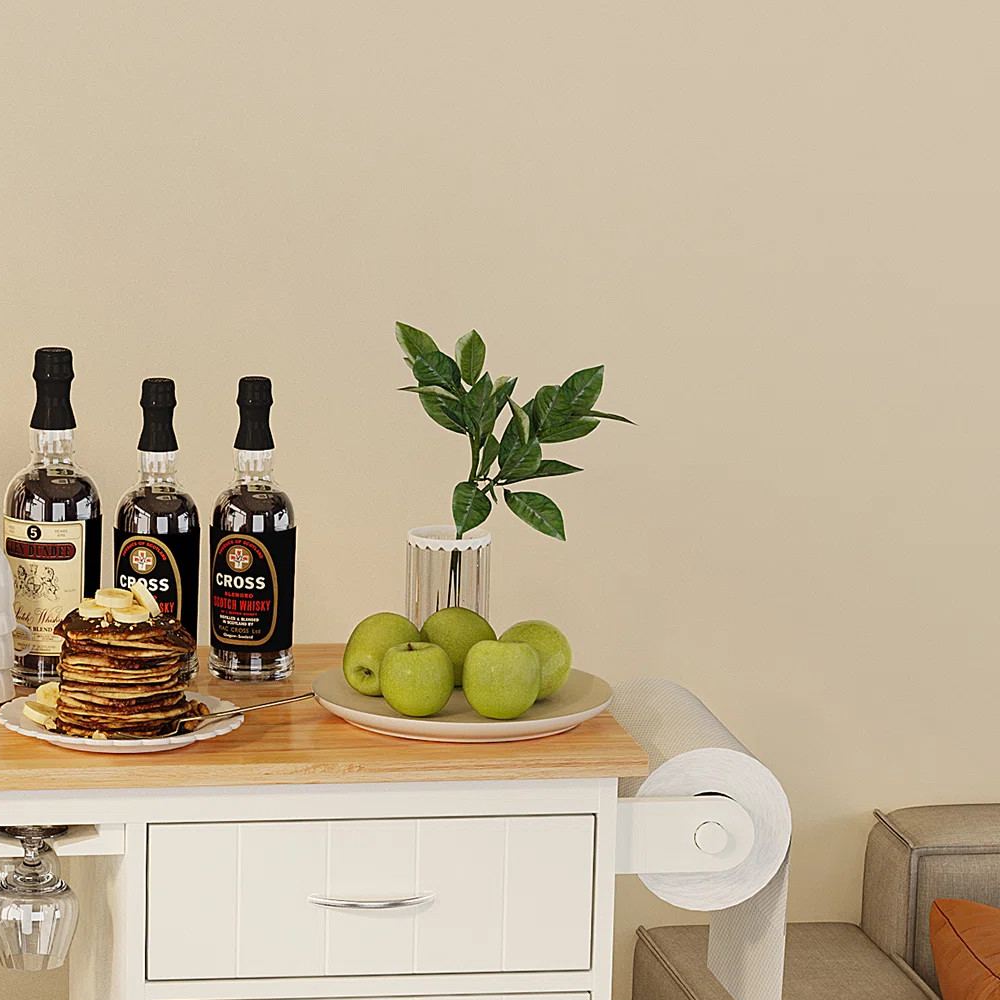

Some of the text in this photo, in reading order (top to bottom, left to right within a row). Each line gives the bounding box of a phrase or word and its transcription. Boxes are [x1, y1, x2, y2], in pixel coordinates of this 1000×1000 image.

[30, 527, 38, 538] 5
[216, 572, 266, 590] CROSS
[239, 600, 271, 611] WHISKY
